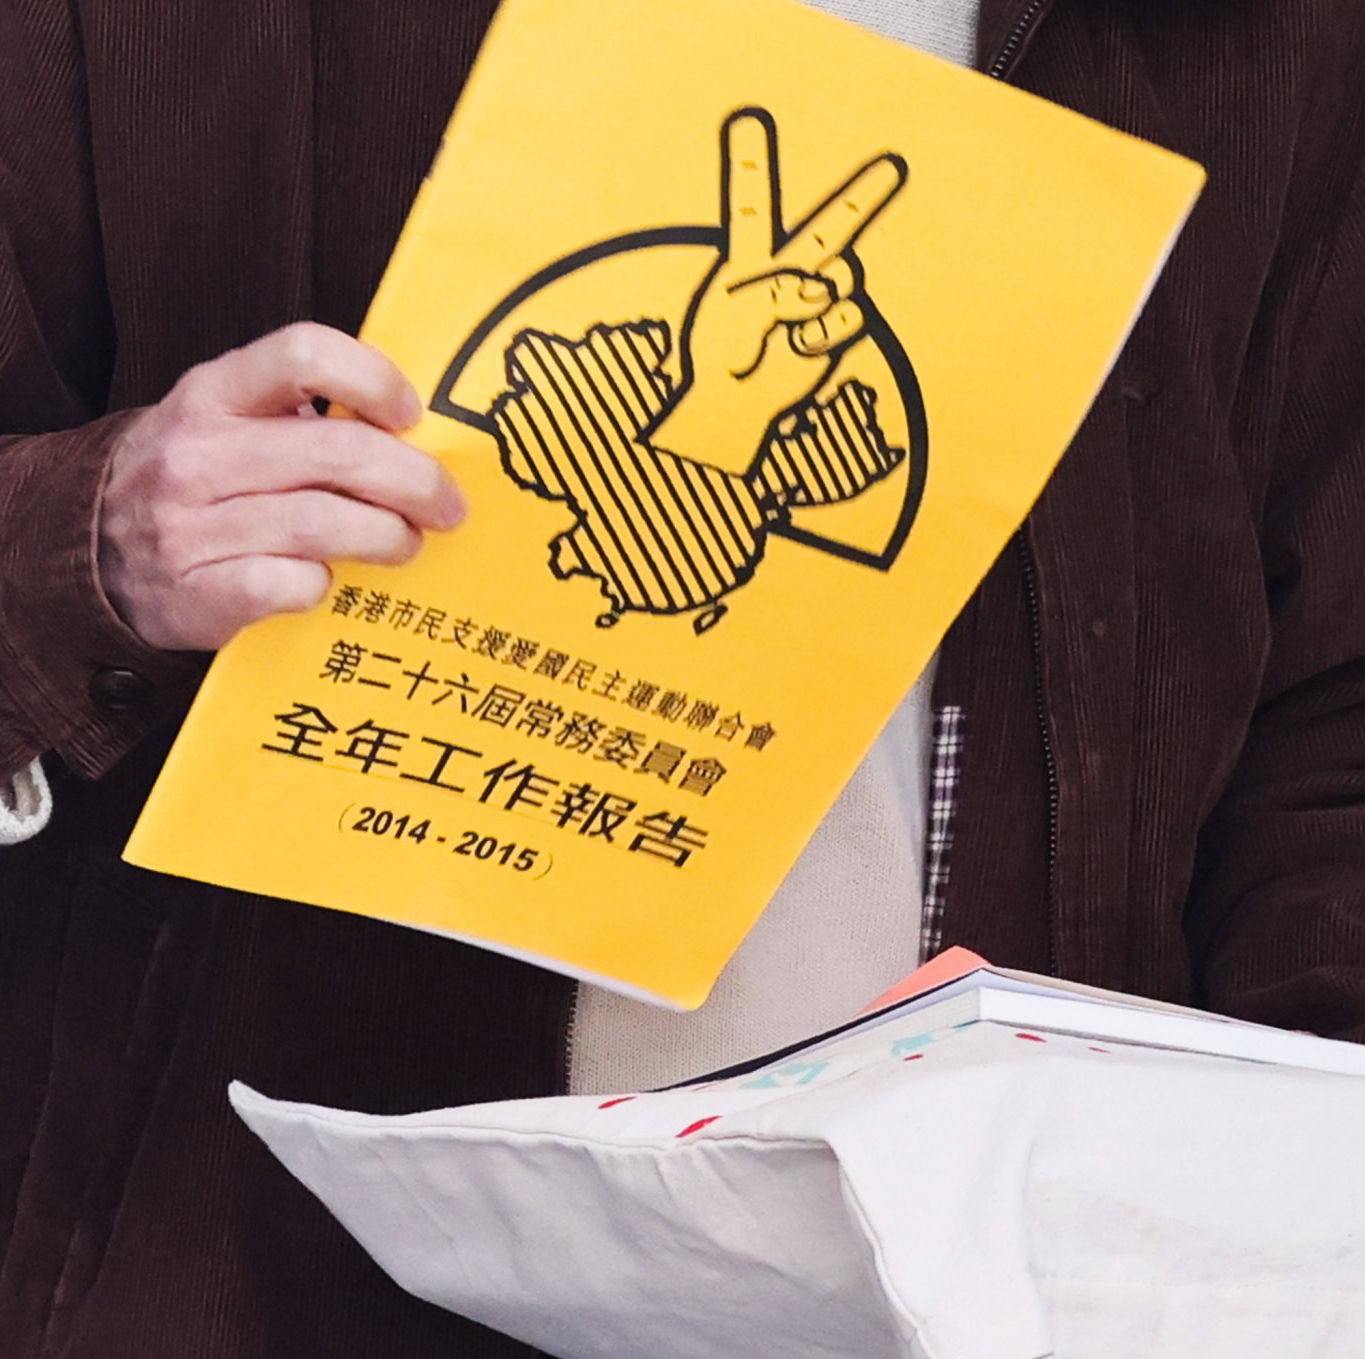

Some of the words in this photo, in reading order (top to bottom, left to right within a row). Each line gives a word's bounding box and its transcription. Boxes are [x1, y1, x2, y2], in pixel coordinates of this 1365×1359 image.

[331, 583, 776, 753] 香港市民支援愛國民主運動聯合會
[261, 701, 710, 869] 全年工作報告
